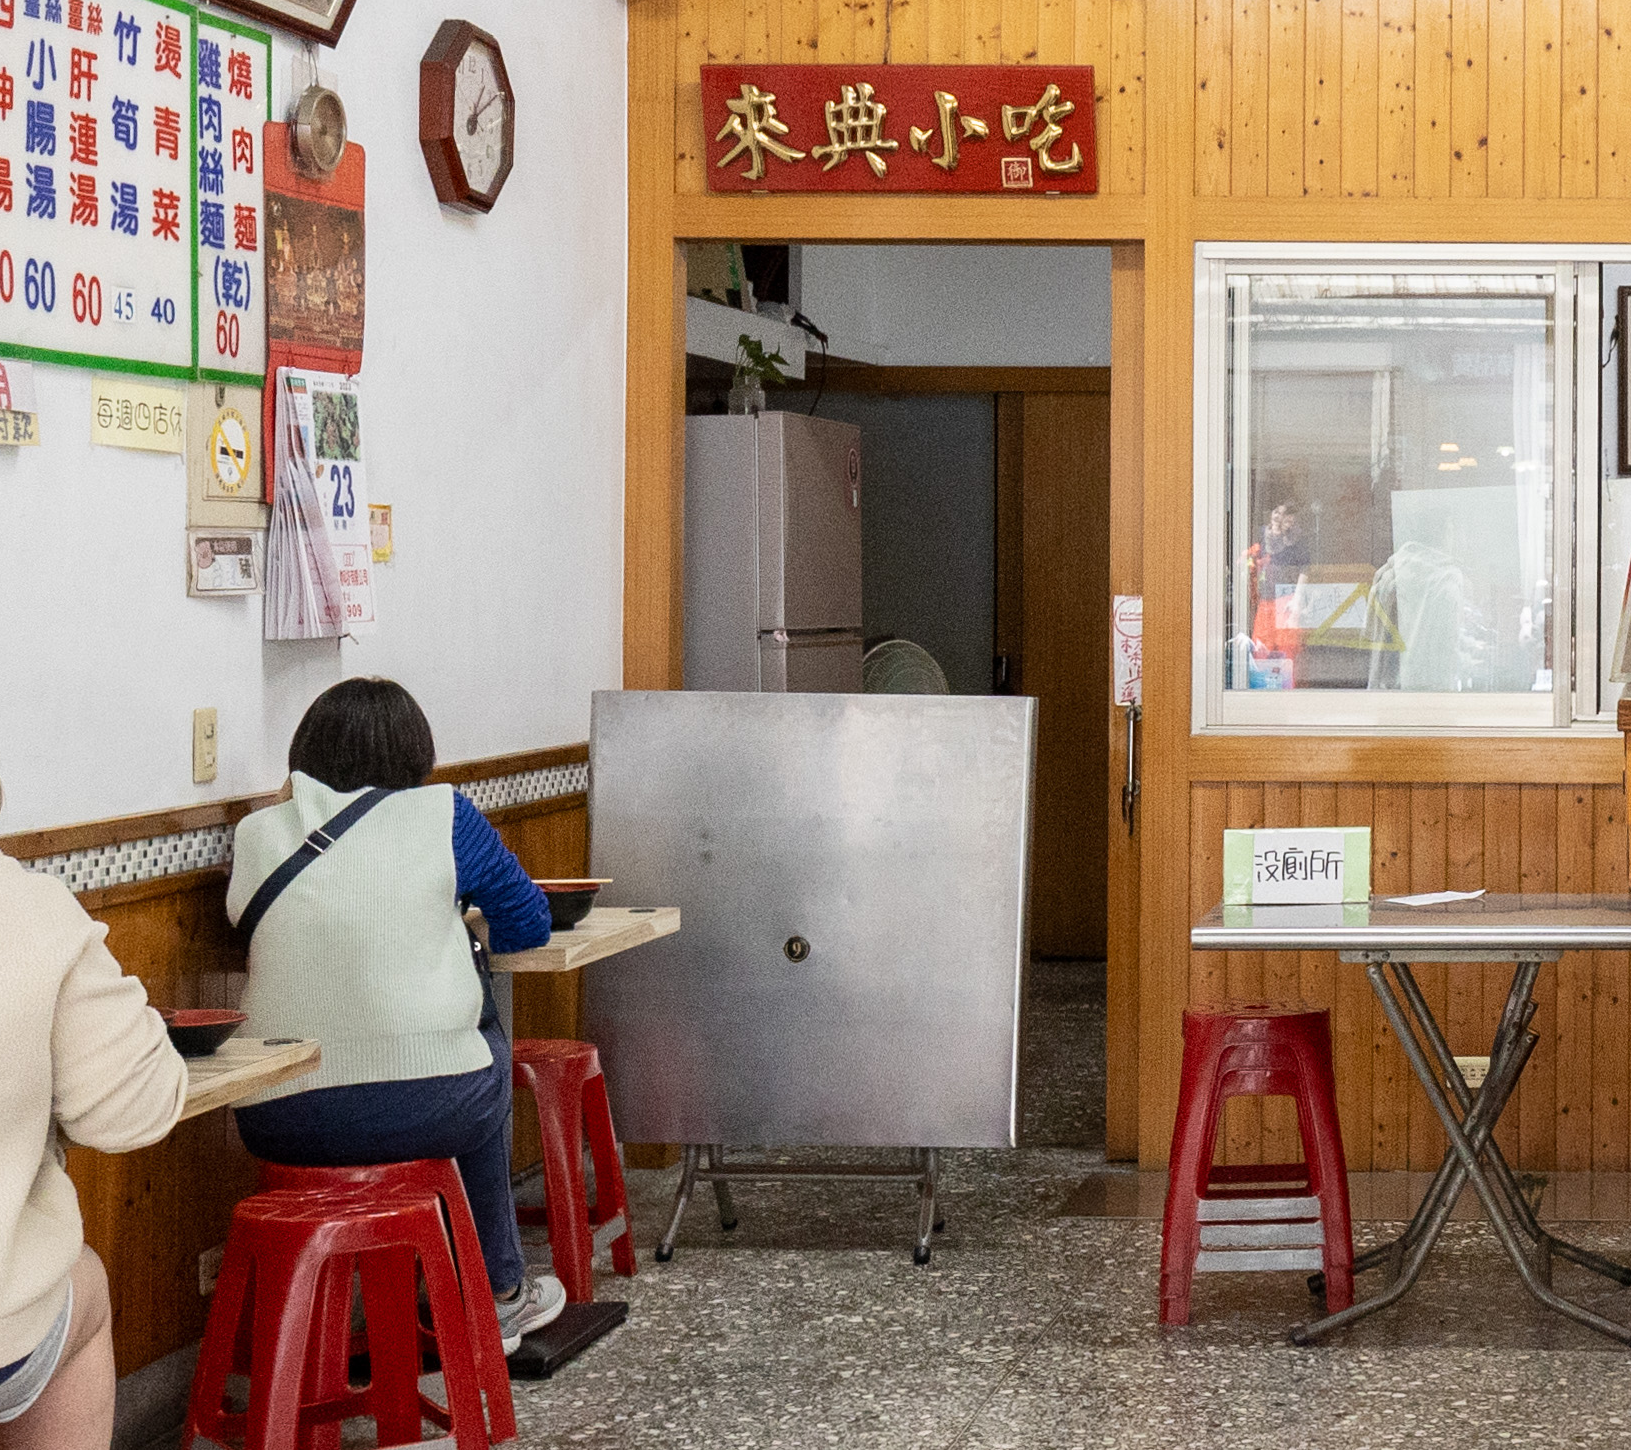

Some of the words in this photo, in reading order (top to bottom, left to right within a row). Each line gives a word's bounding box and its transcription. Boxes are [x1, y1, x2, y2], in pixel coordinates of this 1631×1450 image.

[109, 10, 142, 237] 竹筍湯
[151, 21, 183, 243] 燙青菜
[197, 37, 226, 251] 雞肉絲麵
[227, 48, 258, 252] 燒肉麵
[715, 82, 1084, 182] 來典小吃
[25, 257, 56, 313] 60
[72, 272, 103, 326] 60
[113, 291, 135, 321] 45
[150, 297, 176, 326] 40
[215, 309, 240, 359] 60
[329, 464, 355, 519] 23
